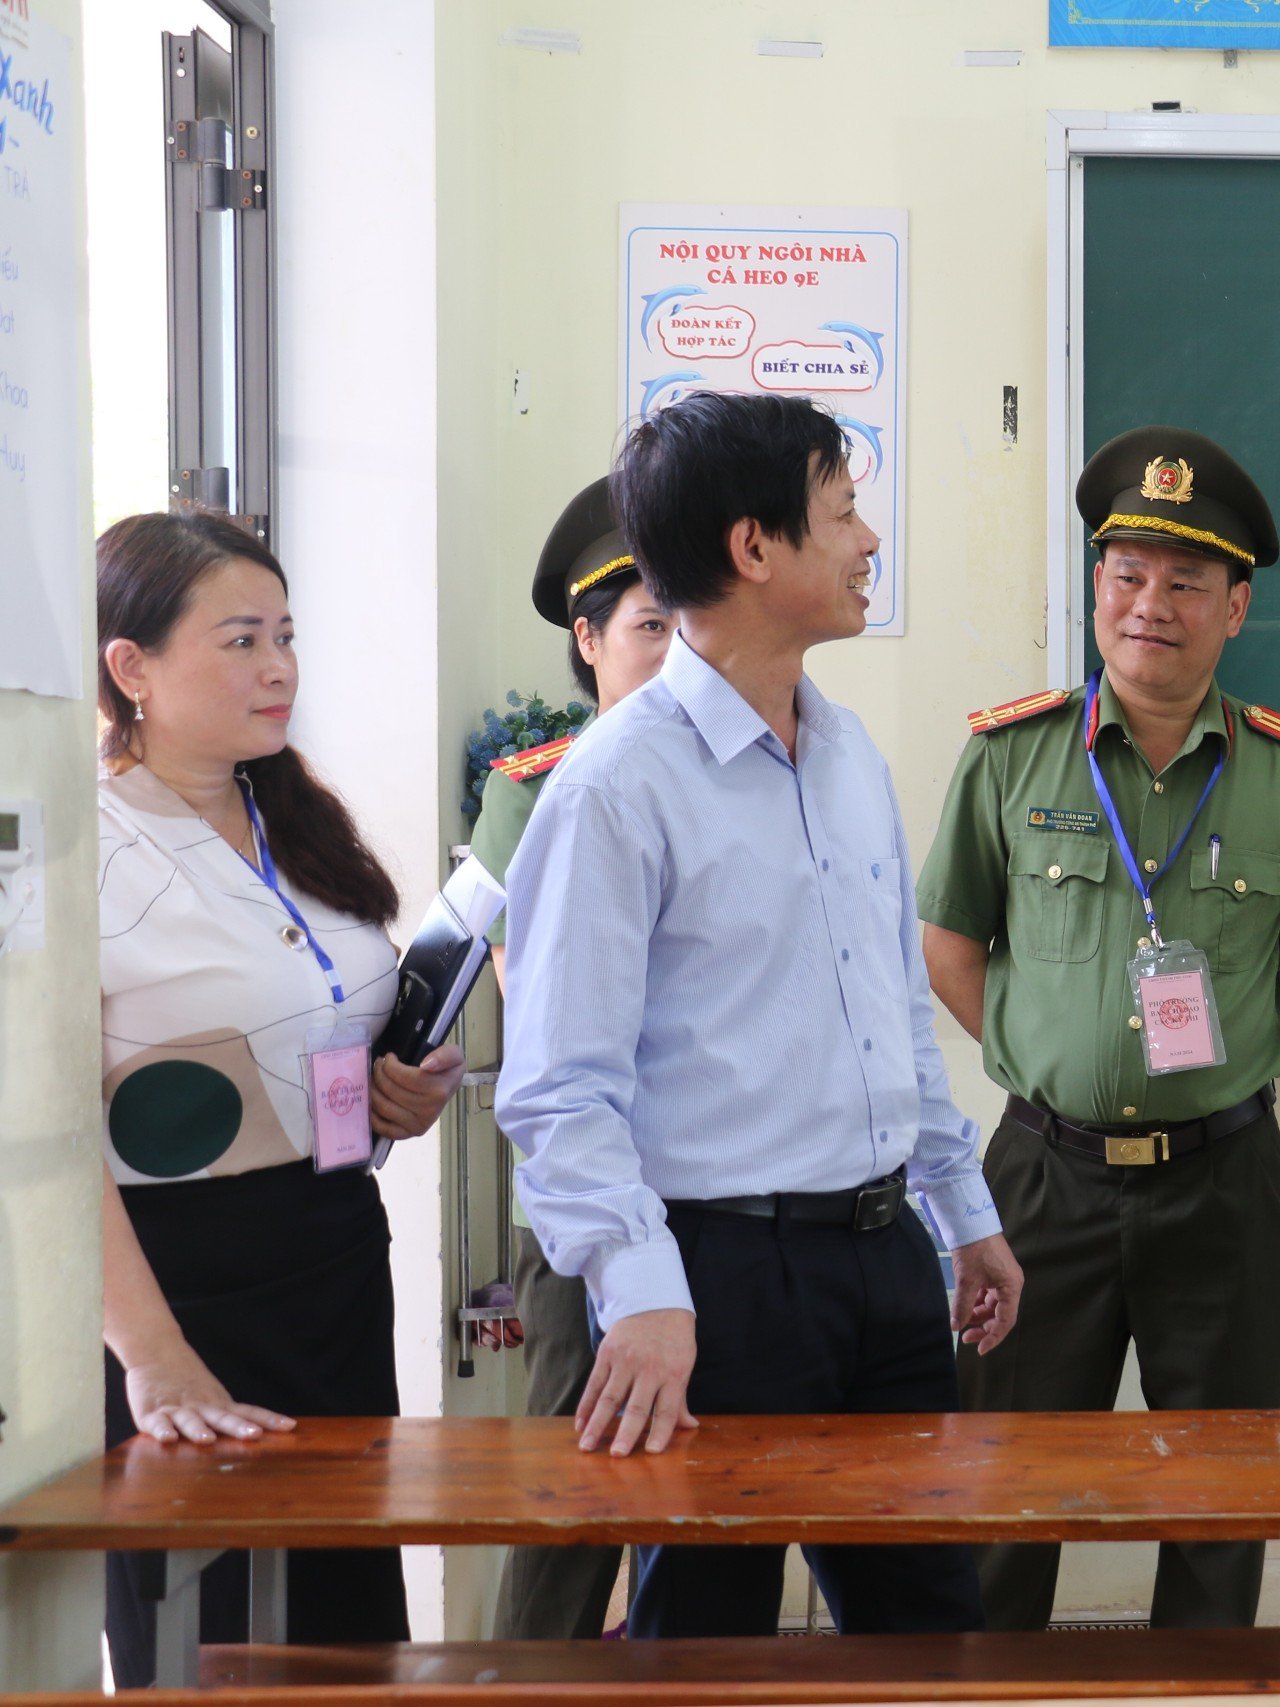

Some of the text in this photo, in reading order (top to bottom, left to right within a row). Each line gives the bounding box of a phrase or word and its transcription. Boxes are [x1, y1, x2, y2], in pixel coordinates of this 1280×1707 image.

[660, 241, 867, 263] NỘI QUY NGÔI NHÀ
[707, 266, 820, 288] CÁ HEO 9E
[671, 316, 742, 330] ĐOÀN KẾT
[677, 334, 736, 348] HỢP TÁC
[762, 358, 870, 375] BIẾT CHIA SẺ
